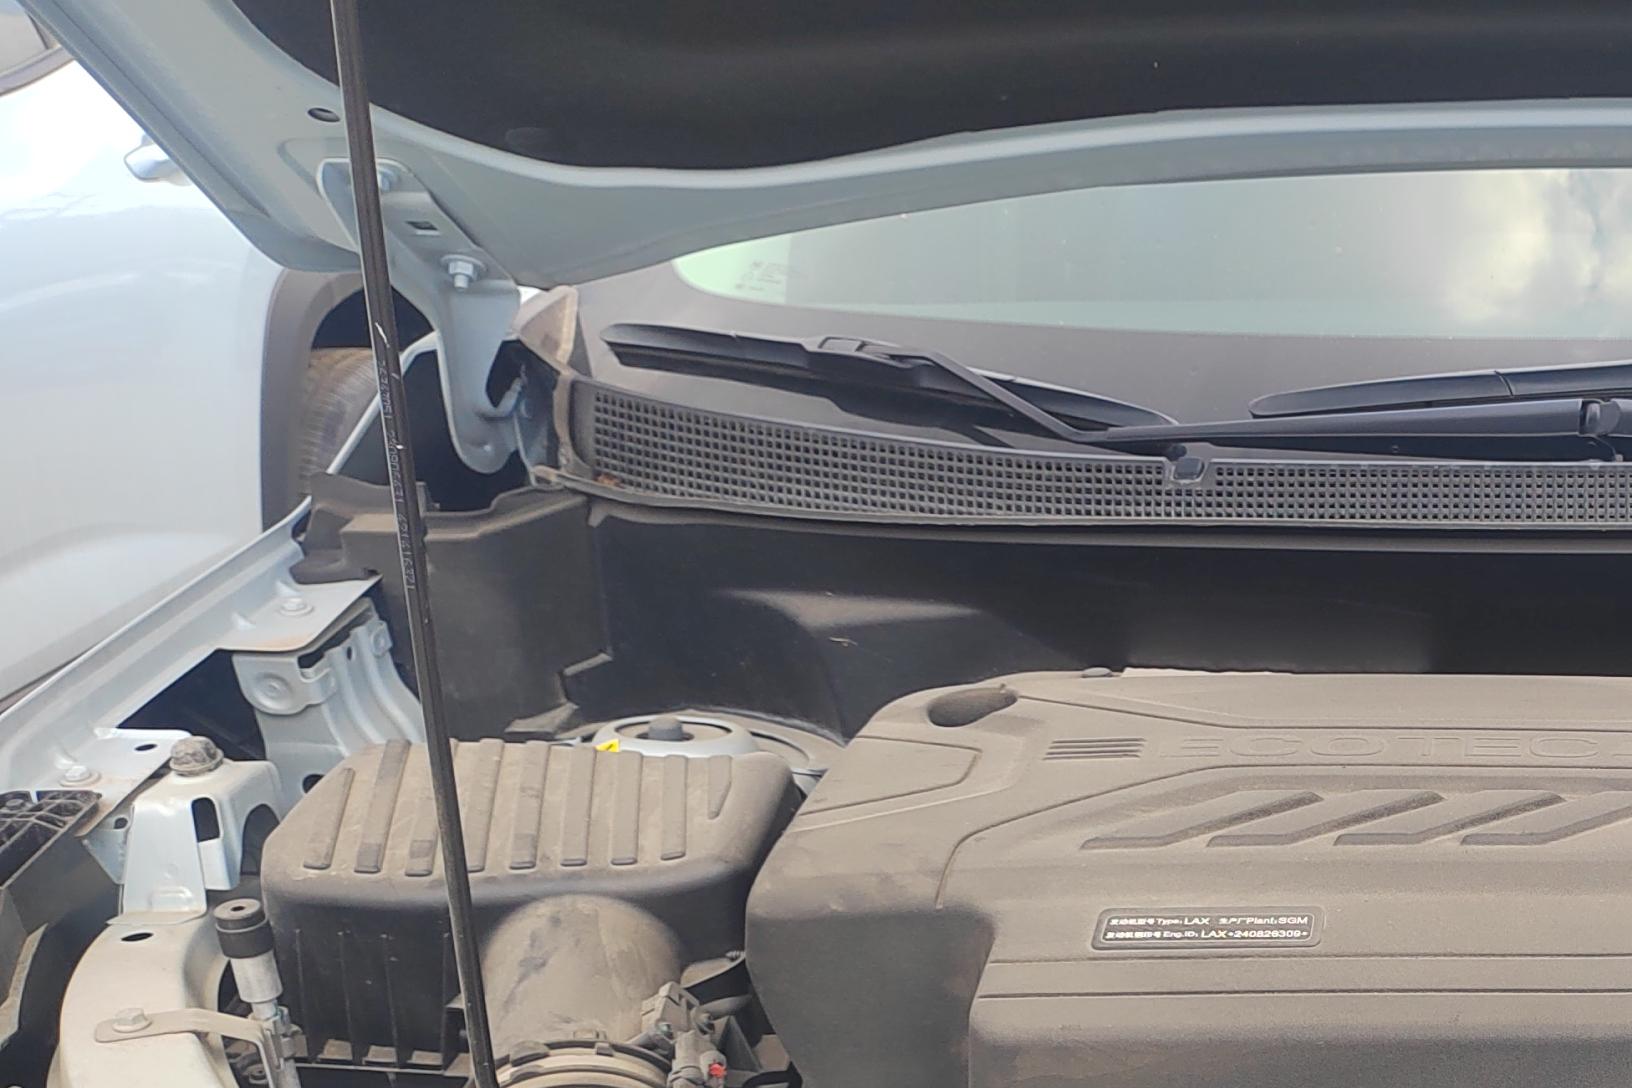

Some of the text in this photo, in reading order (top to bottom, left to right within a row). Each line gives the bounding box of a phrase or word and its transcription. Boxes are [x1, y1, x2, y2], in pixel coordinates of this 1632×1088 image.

[1160, 736, 1600, 758] ECOTEC
[1183, 917, 1210, 925] LAX
[1278, 916, 1308, 925] SGM
